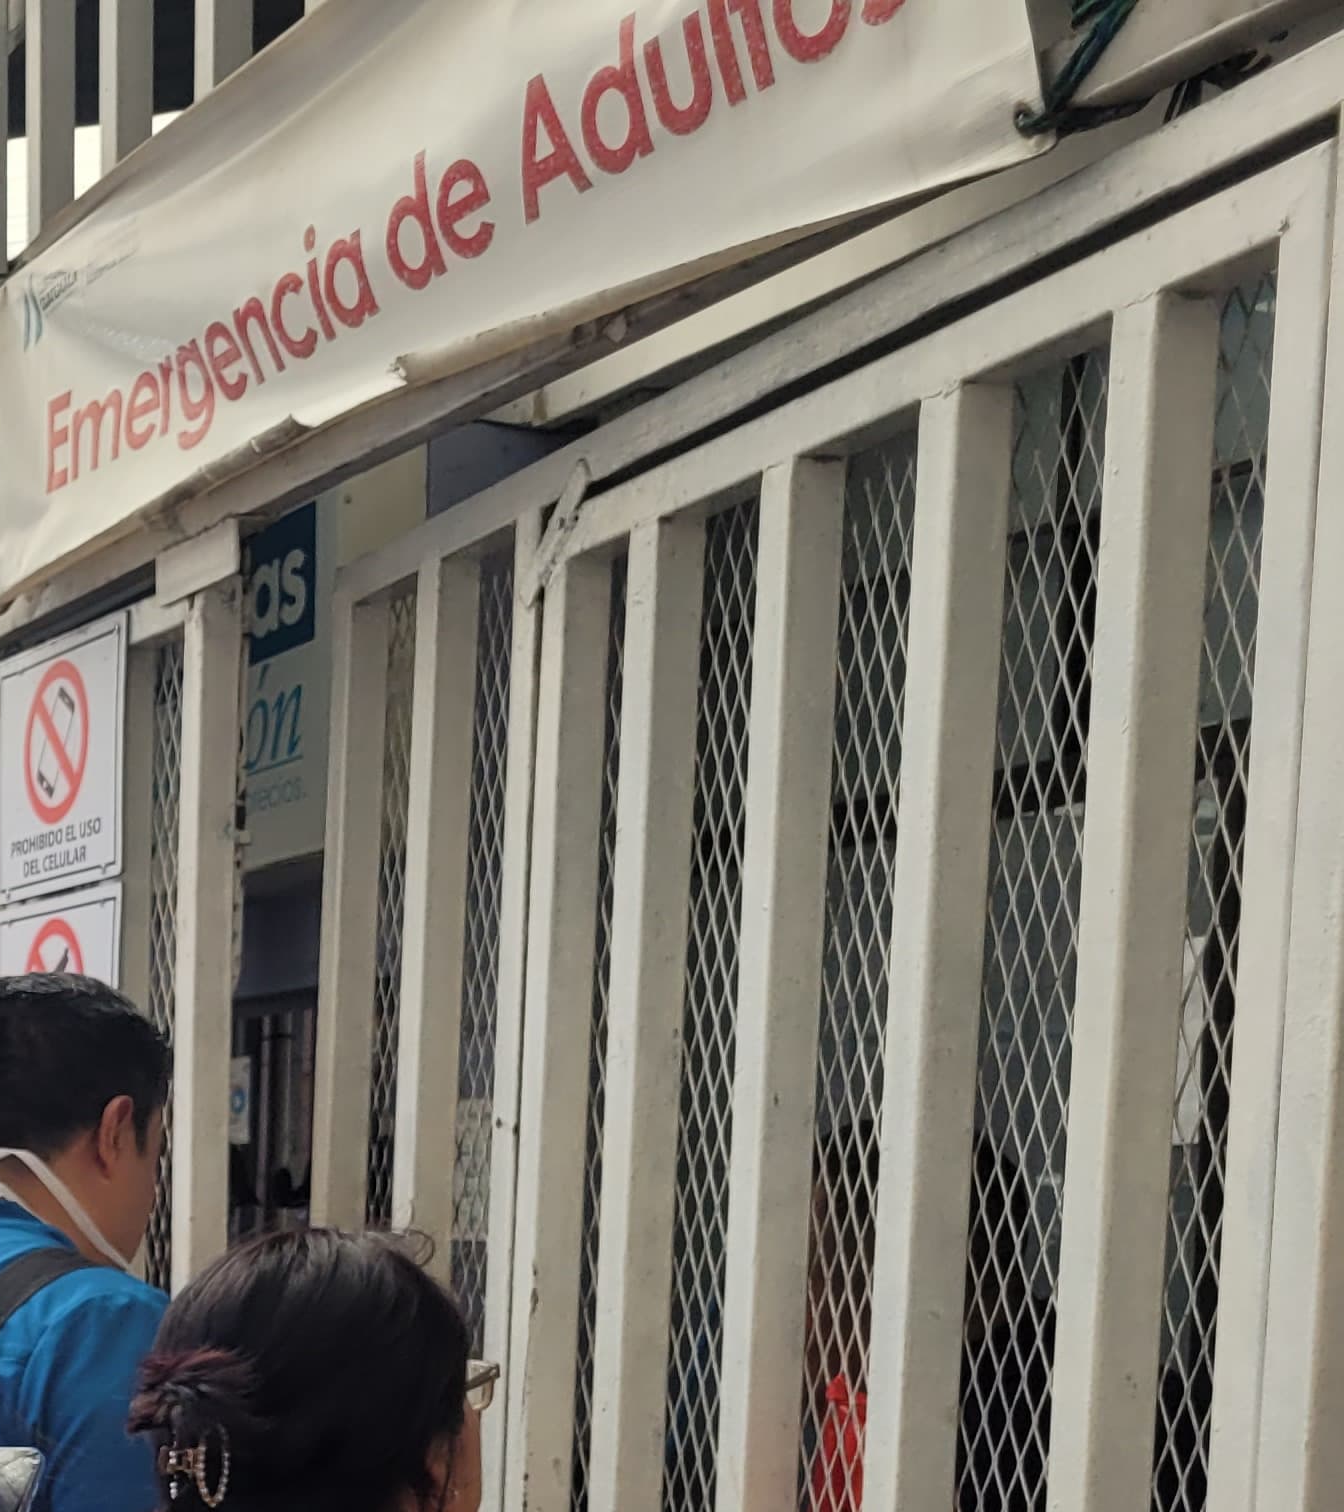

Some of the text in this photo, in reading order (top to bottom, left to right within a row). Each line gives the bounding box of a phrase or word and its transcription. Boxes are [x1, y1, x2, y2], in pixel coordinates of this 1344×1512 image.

[45, 0, 909, 494] Emergencia de Adulto
[248, 549, 307, 638] as
[246, 663, 303, 770] ón
[11, 817, 102, 857] PROHIBIDO EL USO
[23, 845, 87, 878] DEL CELULAR
